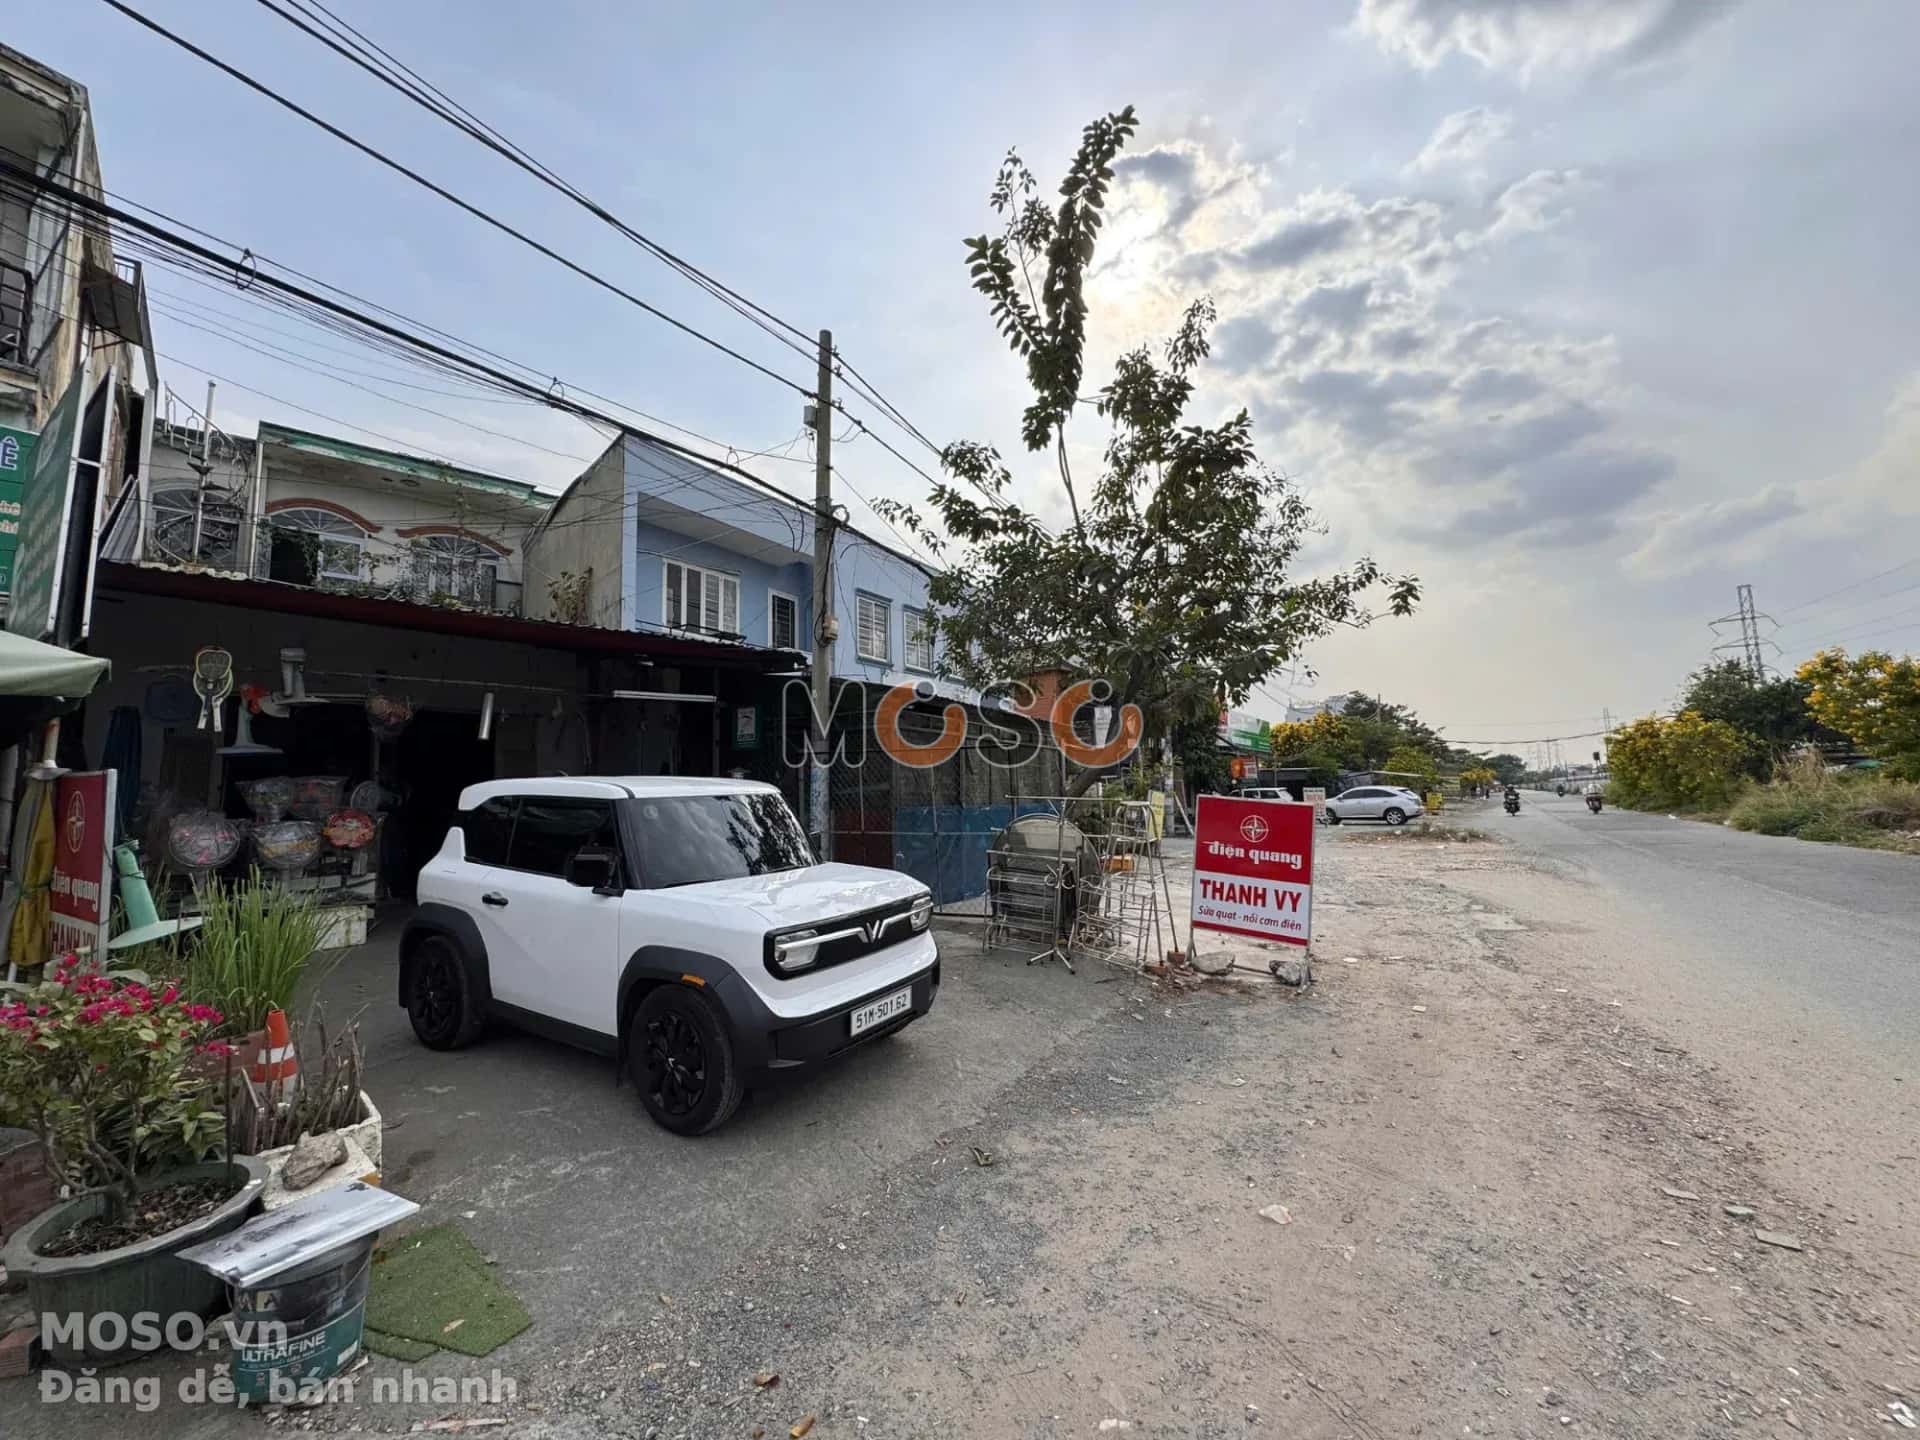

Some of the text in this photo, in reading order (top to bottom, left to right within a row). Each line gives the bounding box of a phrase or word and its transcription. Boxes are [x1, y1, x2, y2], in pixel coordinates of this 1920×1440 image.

[1202, 841, 1302, 870] điện quang
[72, 877, 99, 912] quang
[1200, 878, 1302, 913] THANH VY
[242, 1330, 326, 1363] ULTRAFINE
